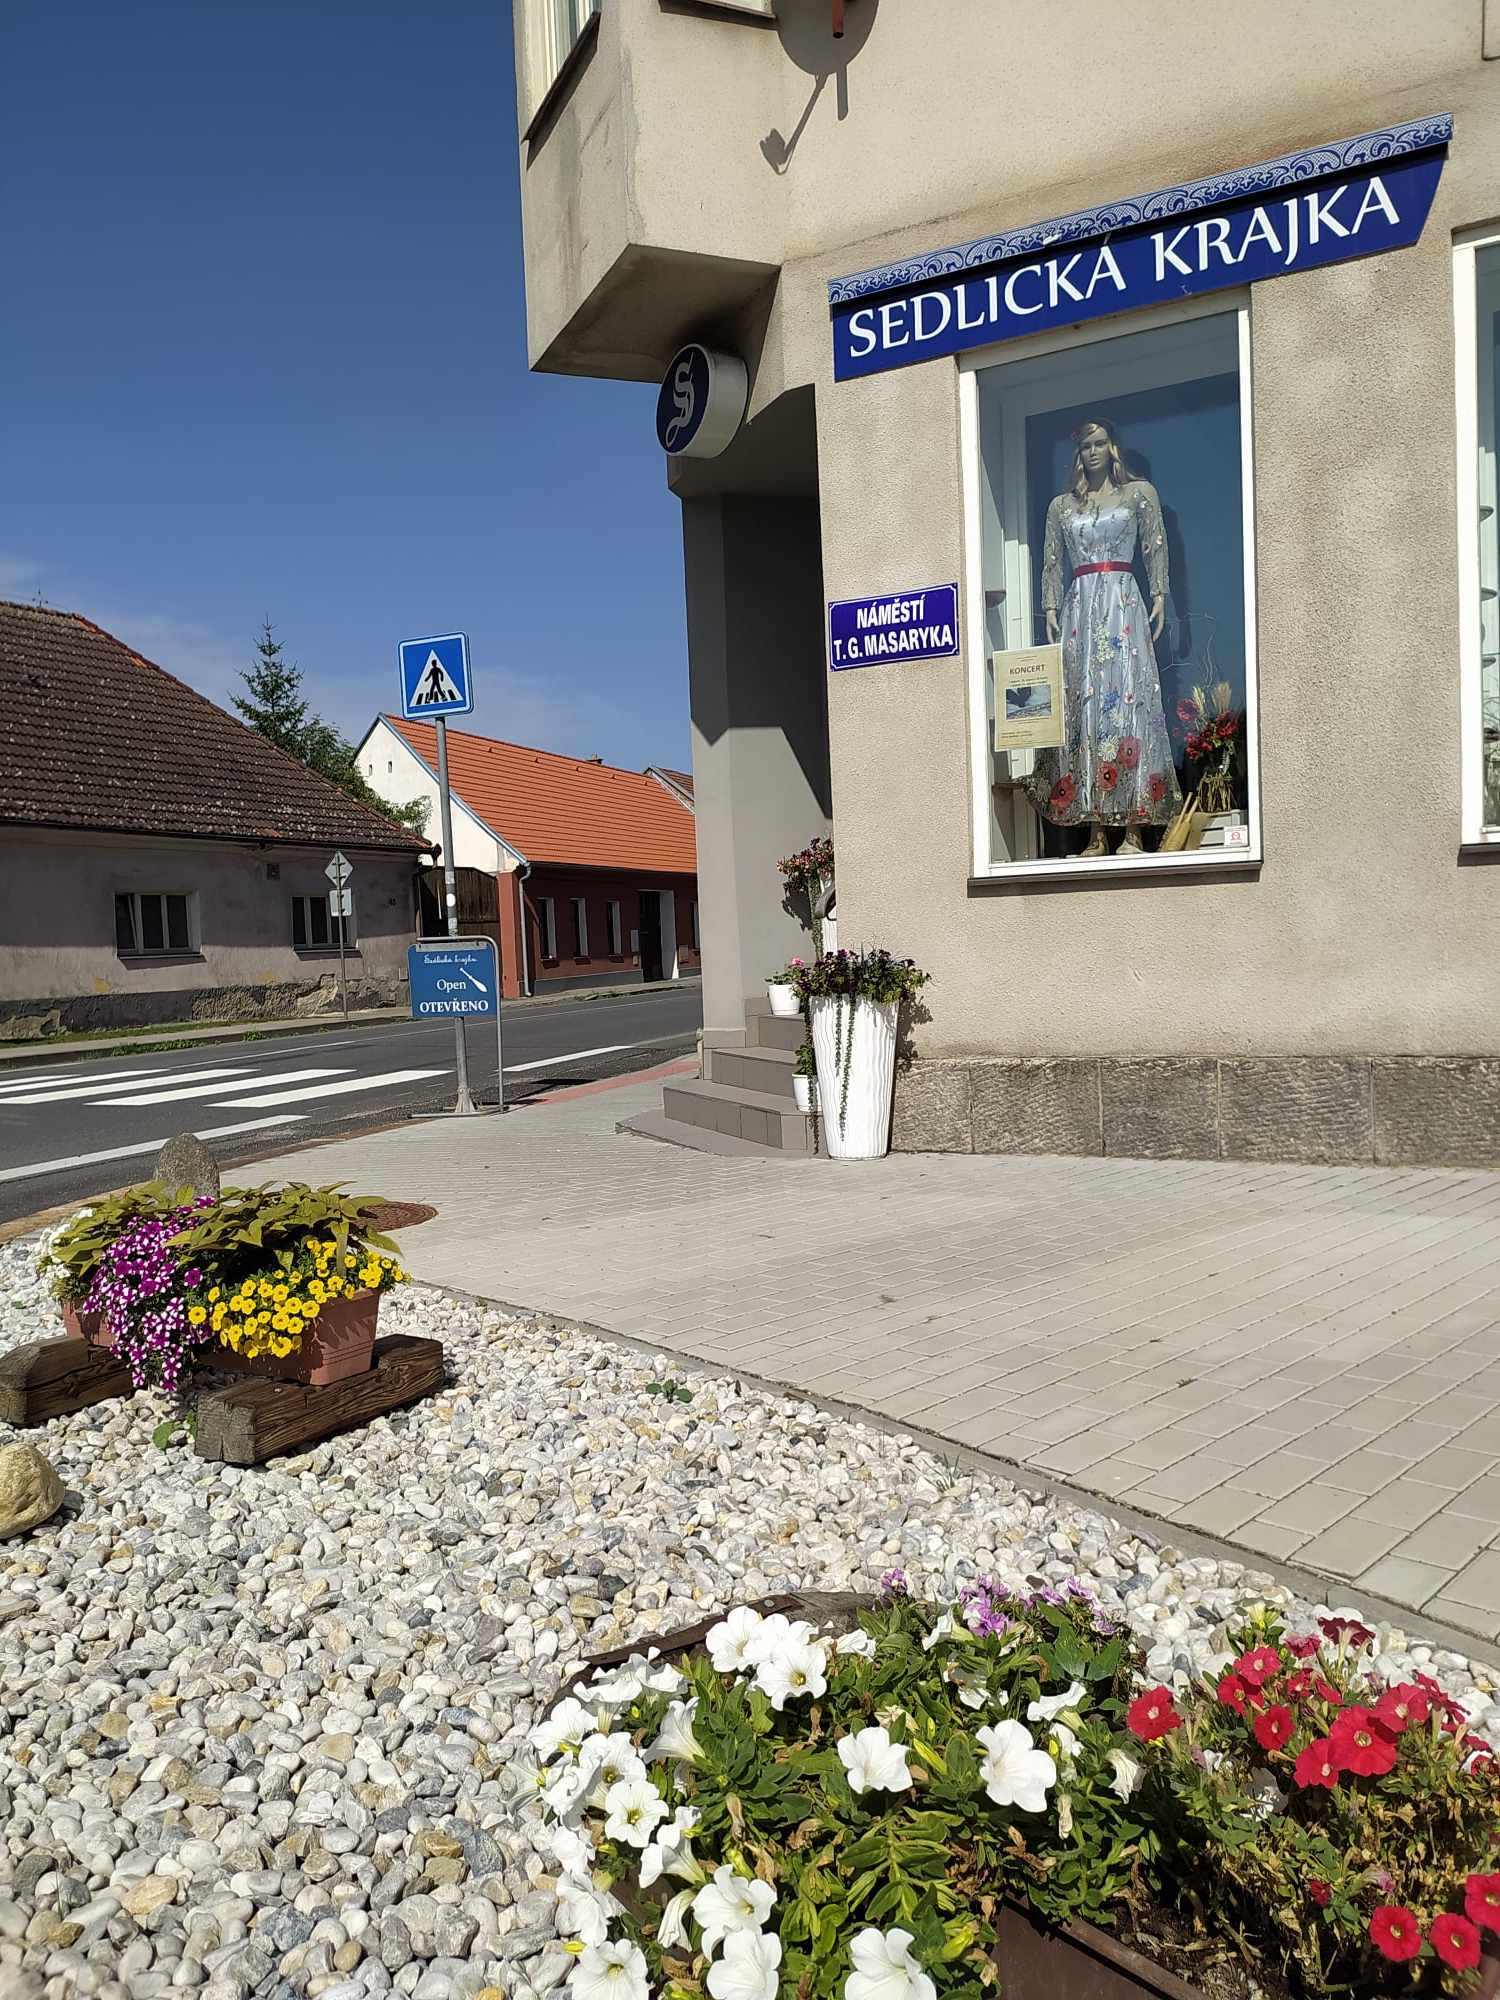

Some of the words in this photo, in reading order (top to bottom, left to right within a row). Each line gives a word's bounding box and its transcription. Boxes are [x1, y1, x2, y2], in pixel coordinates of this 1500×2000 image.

[848, 231, 1127, 359] SEDLICKÁ
[1149, 176, 1401, 282] KRAJKA
[857, 594, 926, 629] NÁMĚSTÍ
[1009, 663, 1046, 675] KONCERT
[436, 978, 467, 993] Open
[419, 997, 489, 1013] OTEVŘENO
